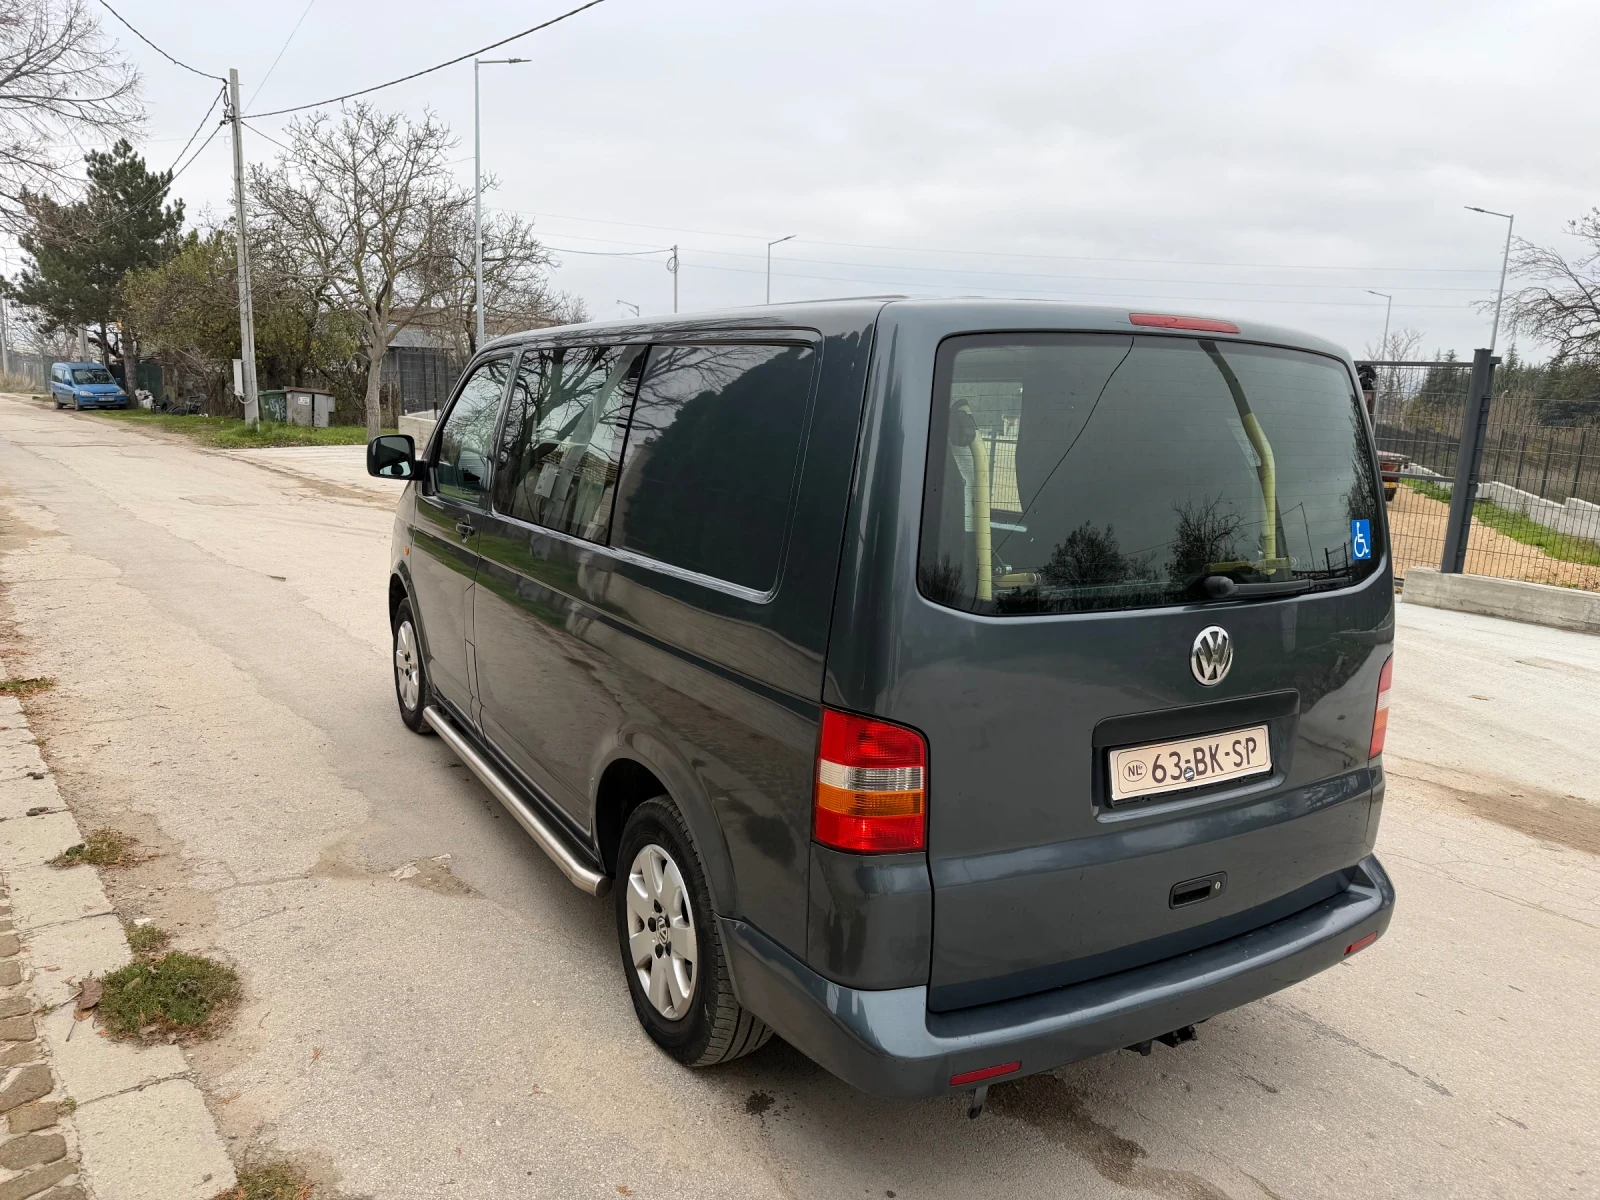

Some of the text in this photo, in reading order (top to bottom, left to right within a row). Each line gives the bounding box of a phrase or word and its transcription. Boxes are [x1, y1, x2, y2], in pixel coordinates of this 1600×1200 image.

[1192, 626, 1233, 686] VW
[1127, 763, 1143, 778] NL
[1151, 736, 1257, 784] 63-BK-SP
